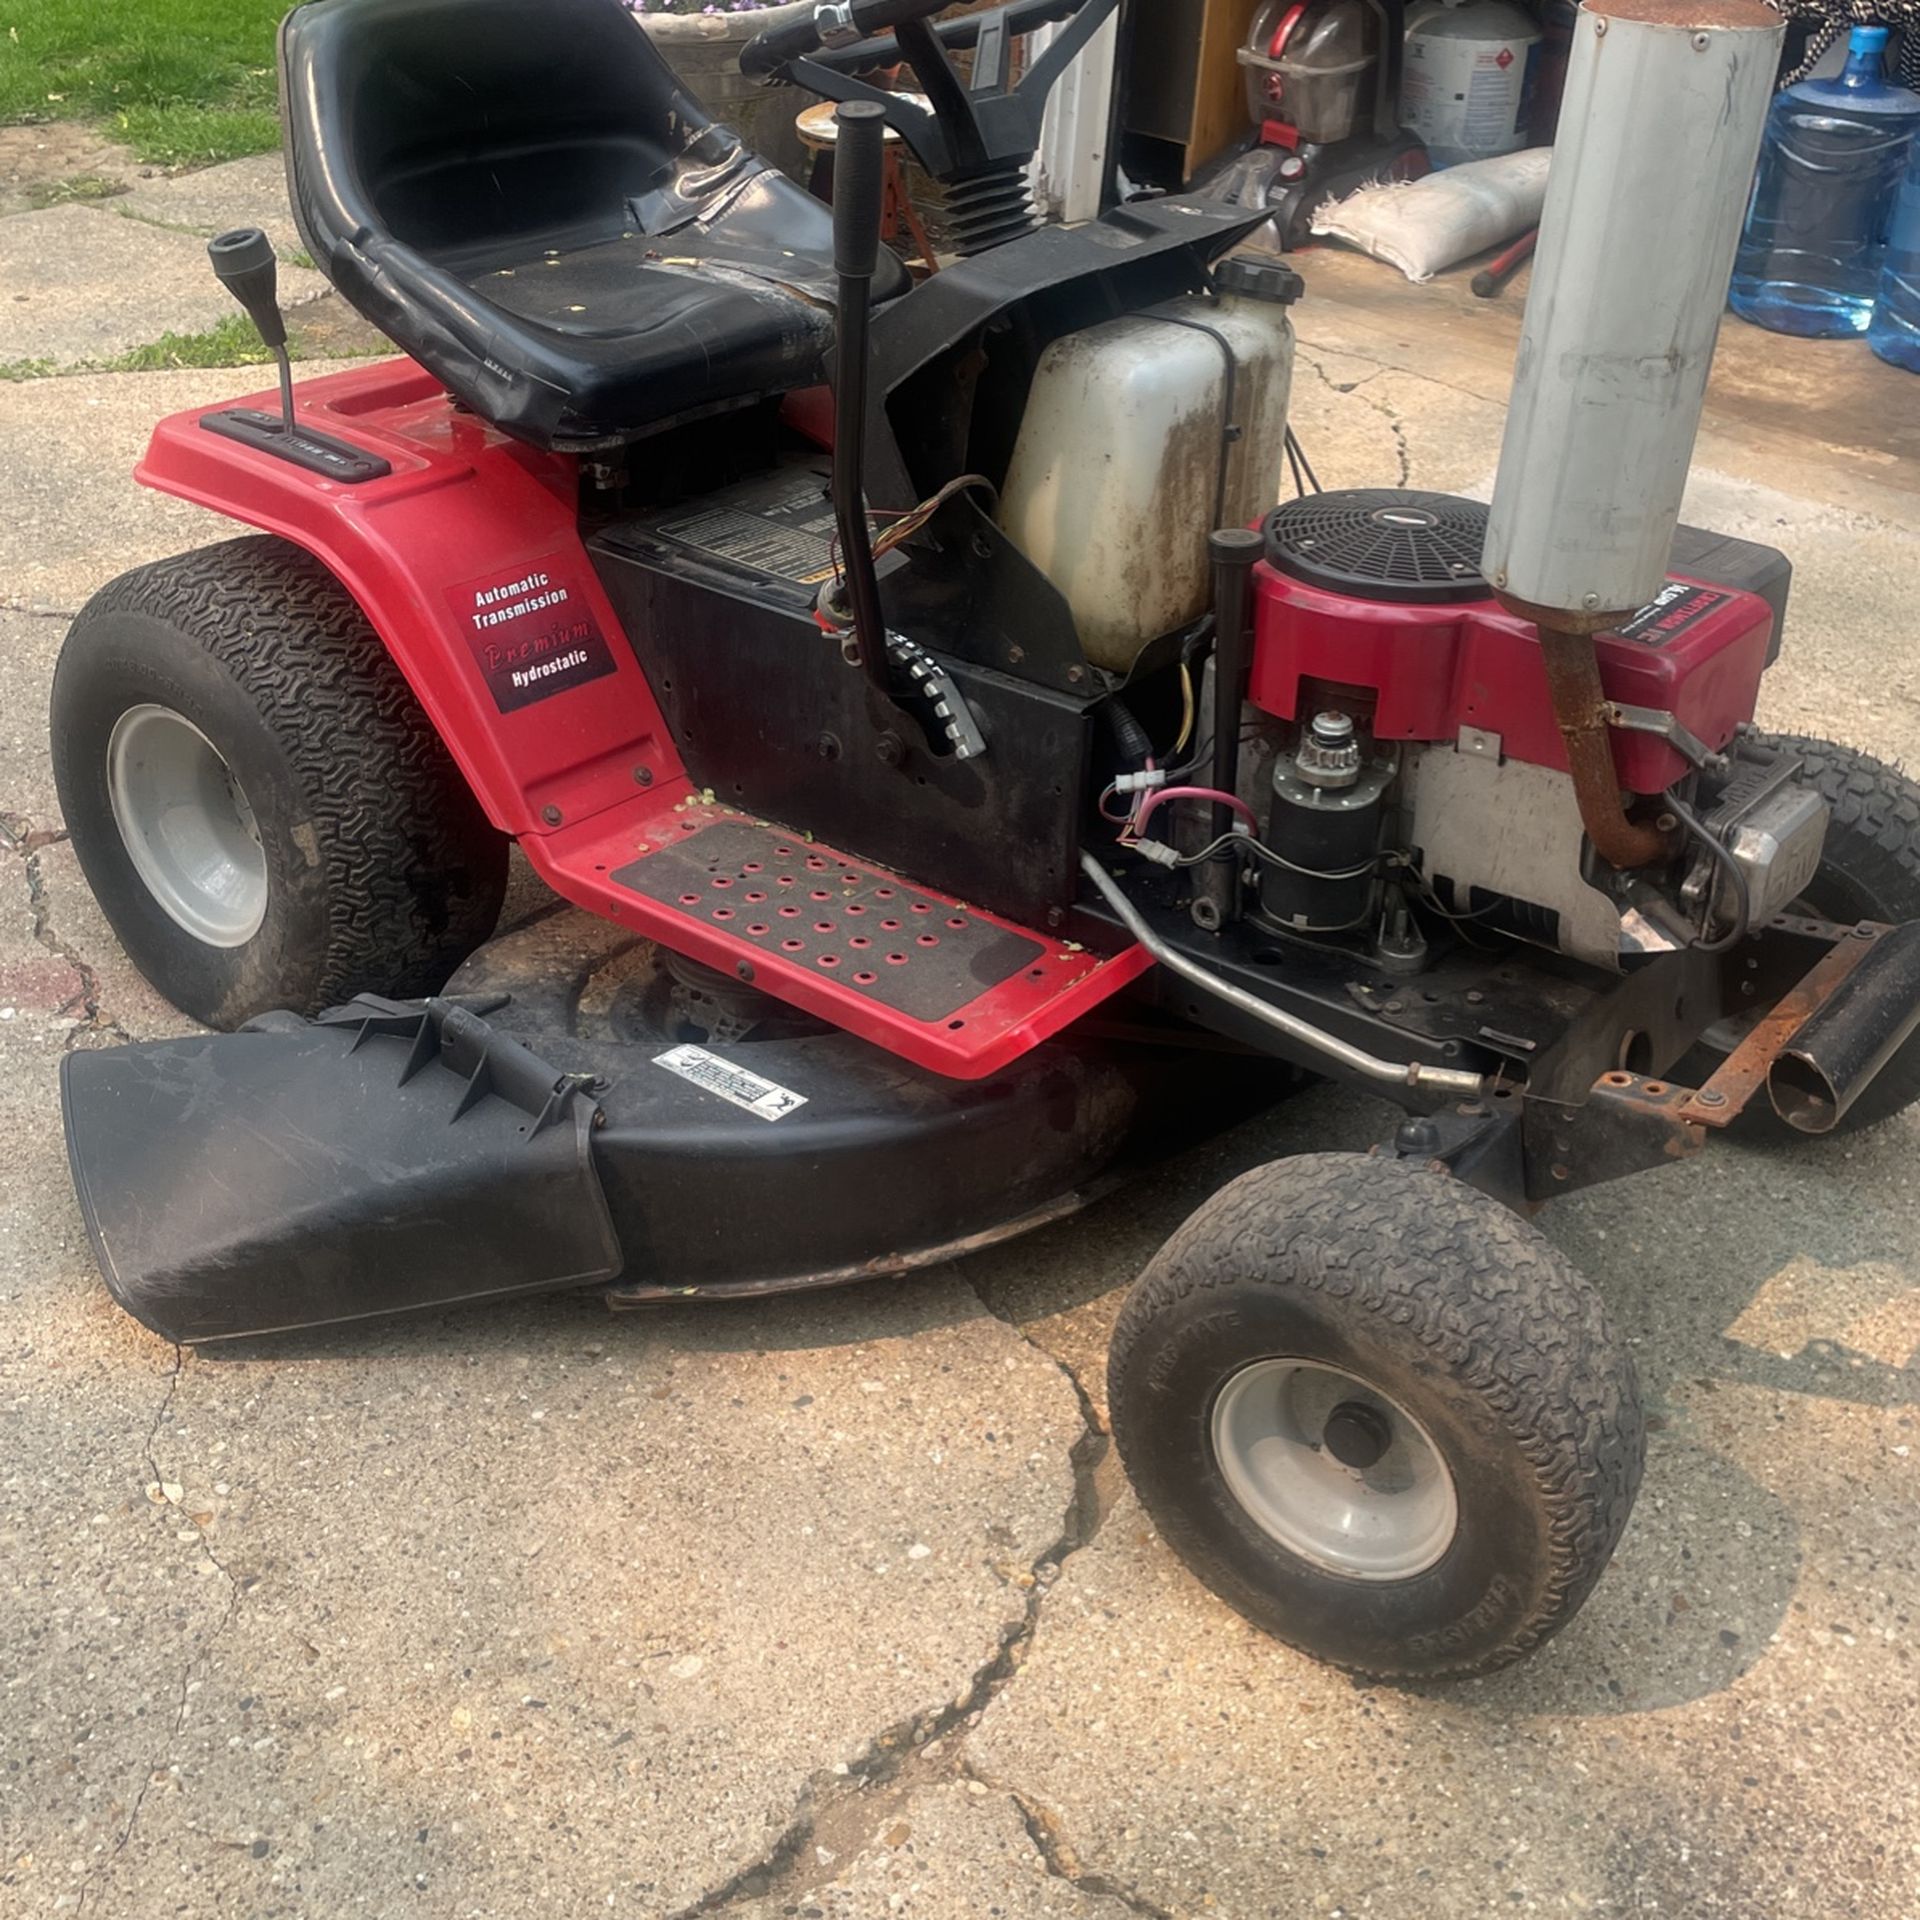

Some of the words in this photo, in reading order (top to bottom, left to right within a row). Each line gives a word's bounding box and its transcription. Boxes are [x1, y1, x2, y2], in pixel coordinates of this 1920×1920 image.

[472, 588, 569, 630] Transmission
[475, 572, 549, 608] Automatic
[484, 622, 590, 670] Premium
[511, 649, 589, 688] Hydrostatic
